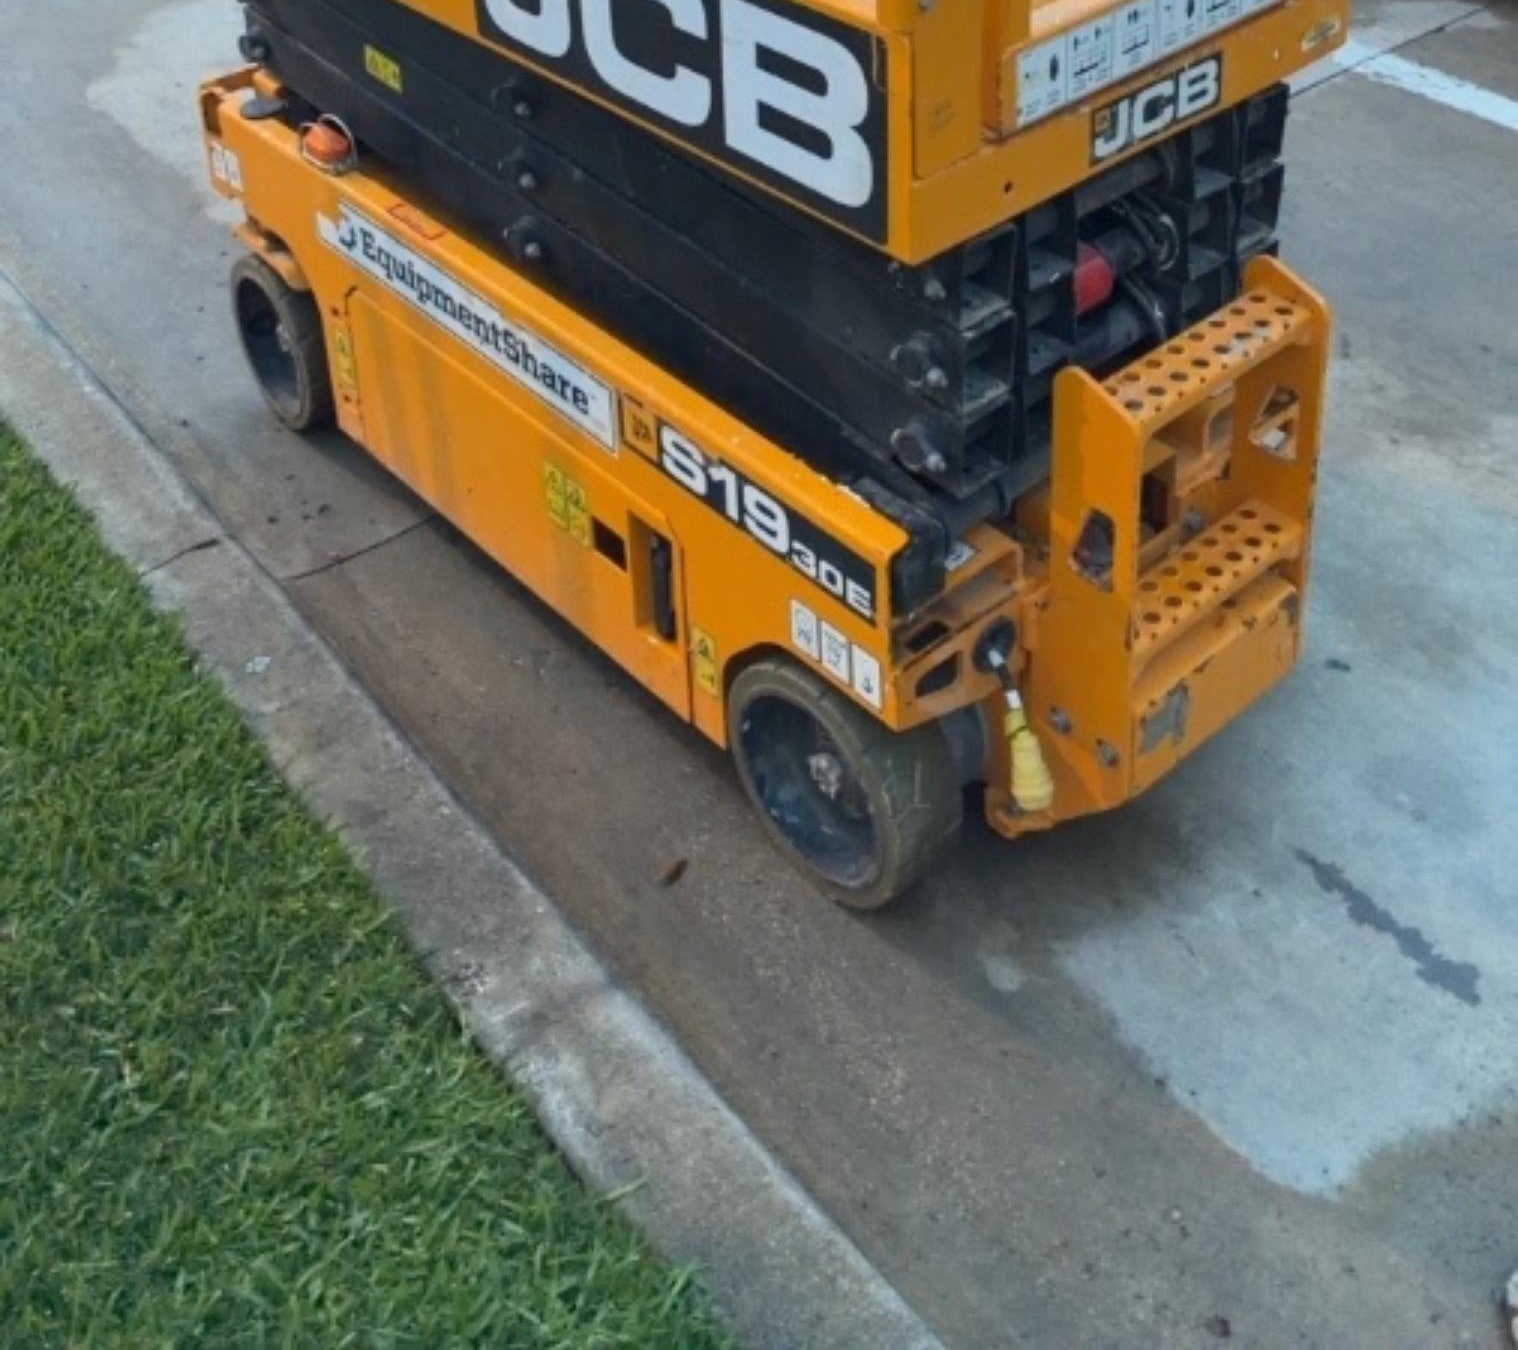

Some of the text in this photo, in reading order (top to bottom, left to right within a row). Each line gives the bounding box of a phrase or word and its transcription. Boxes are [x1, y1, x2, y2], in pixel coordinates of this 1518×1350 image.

[1094, 58, 1219, 157] JCB
[359, 227, 591, 414] EquipmentShare
[661, 424, 789, 553] S19
[789, 539, 873, 619] 30E
